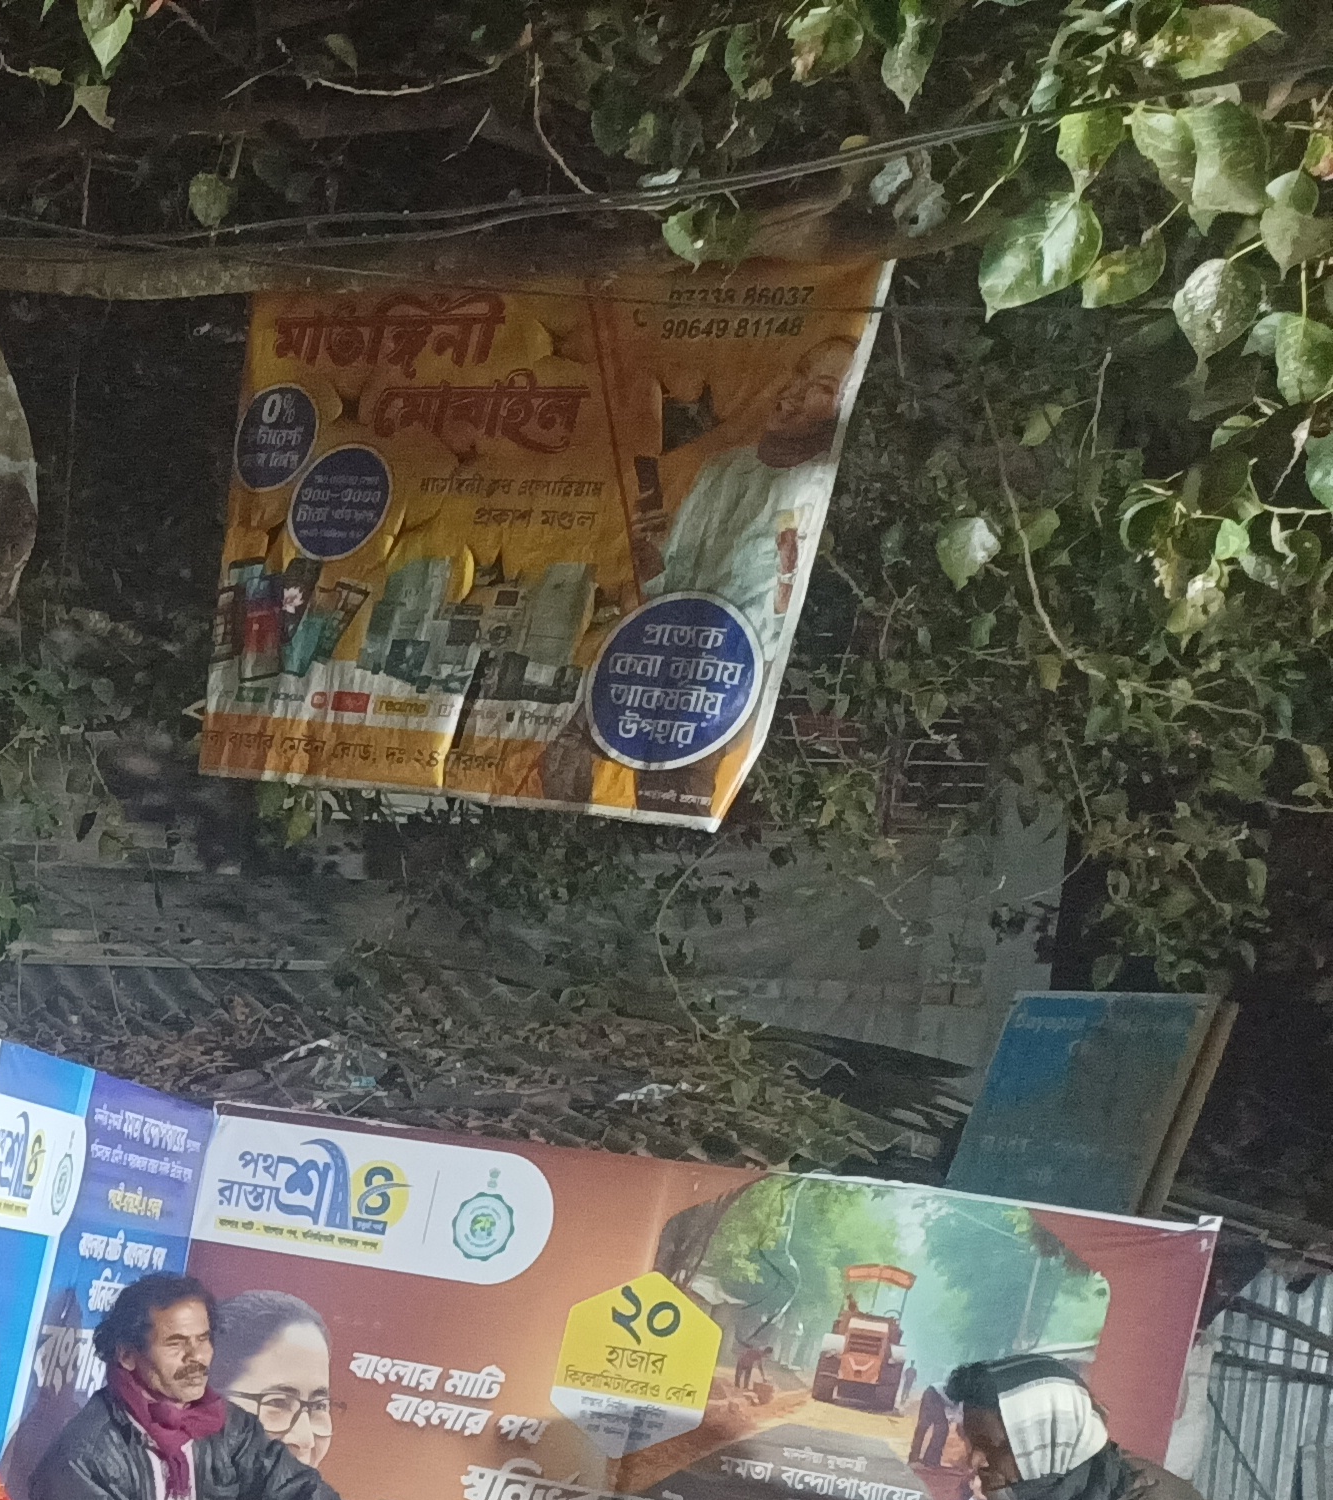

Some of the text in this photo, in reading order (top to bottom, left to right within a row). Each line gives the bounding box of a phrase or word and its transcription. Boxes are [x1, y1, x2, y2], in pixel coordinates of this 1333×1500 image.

[662, 318, 729, 339] 90649
[619, 710, 697, 748] উপহার
[611, 1285, 681, 1346] ২০
[349, 1351, 506, 1401] বাংলার মাটি
[605, 1345, 667, 1376] হাজার
[386, 1393, 494, 1436] বাংলার
[497, 1413, 550, 1445] পথ
[720, 1454, 774, 1484] মমতা
